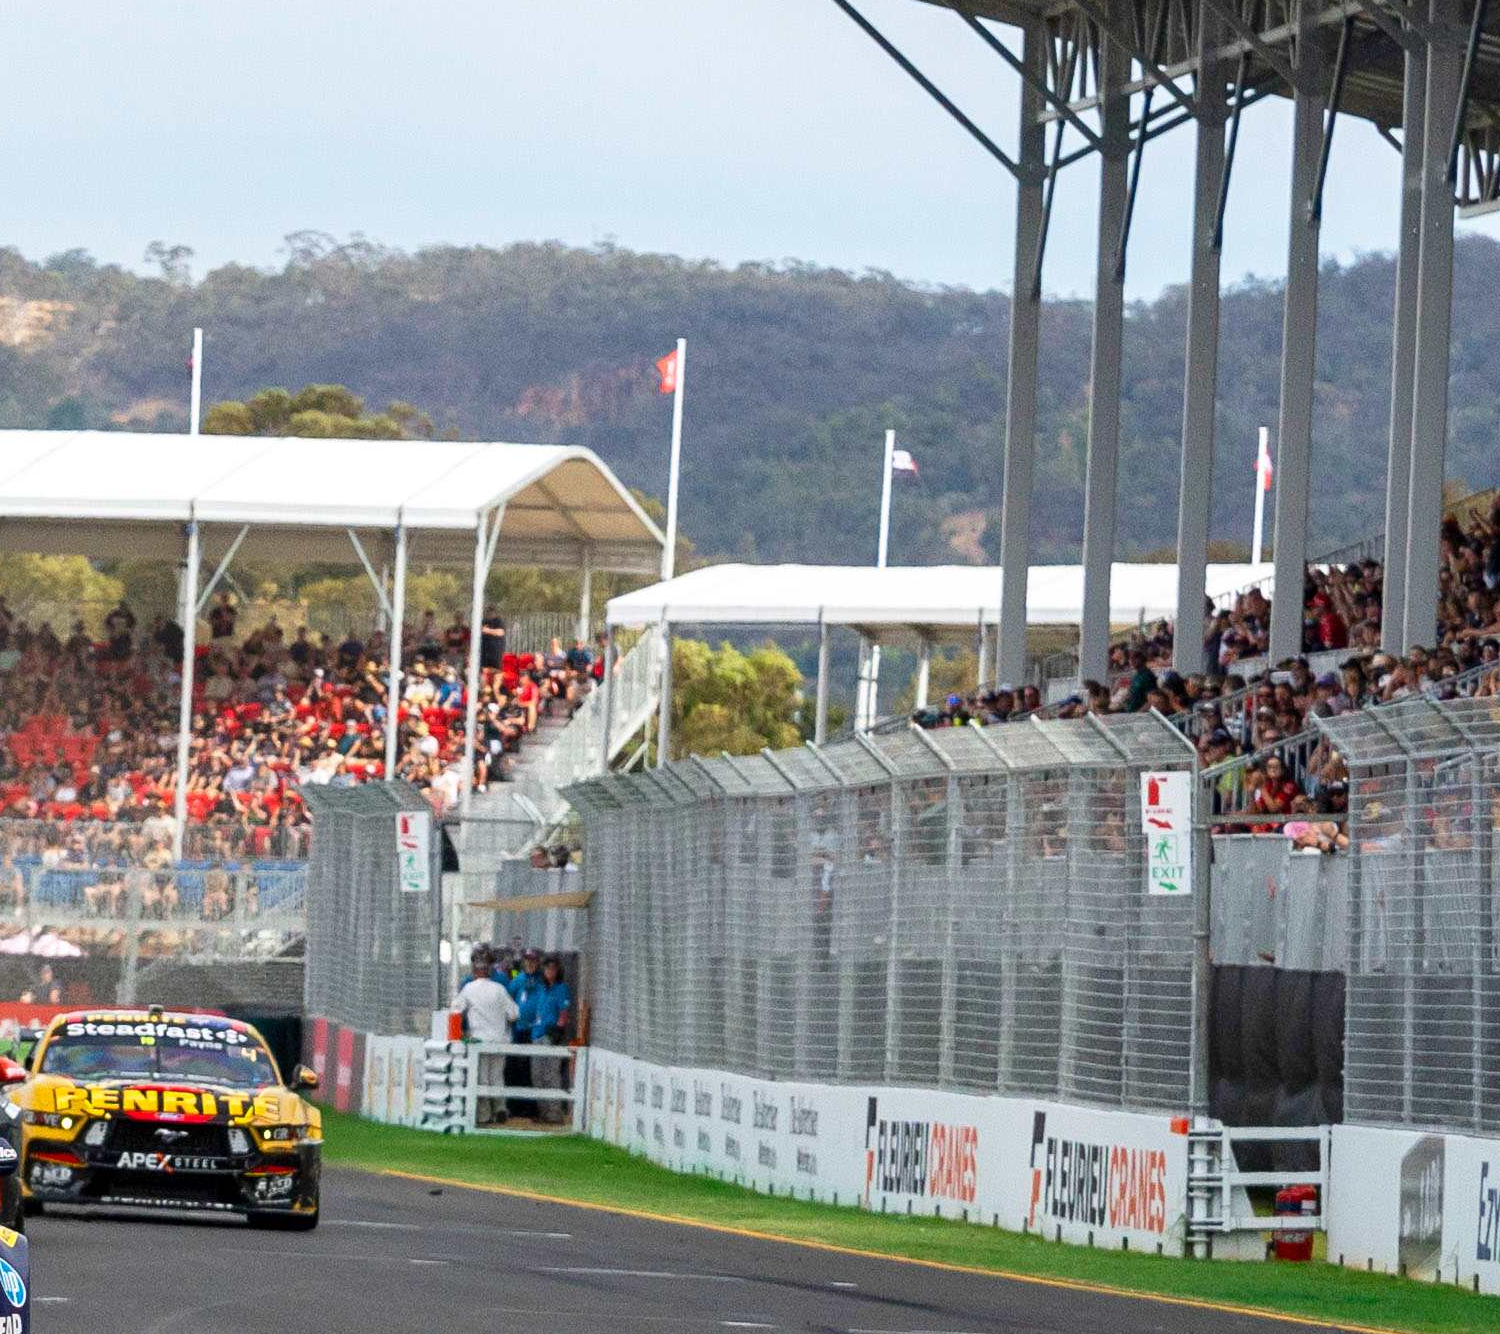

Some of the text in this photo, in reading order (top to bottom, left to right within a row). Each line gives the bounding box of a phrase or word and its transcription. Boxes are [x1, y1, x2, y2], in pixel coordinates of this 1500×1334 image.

[1152, 866, 1184, 879] EXIT
[66, 1022, 214, 1040] Steadfast
[179, 1038, 223, 1050] Payne
[240, 1046, 257, 1063] 4
[53, 1086, 282, 1125] PENRITE
[116, 1151, 217, 1174] APEX STEEL
[876, 1119, 978, 1203] FLEURIEU CRANES
[1044, 1136, 1167, 1234] FLEURIEU CRANES
[0, 1260, 21, 1305] hp
